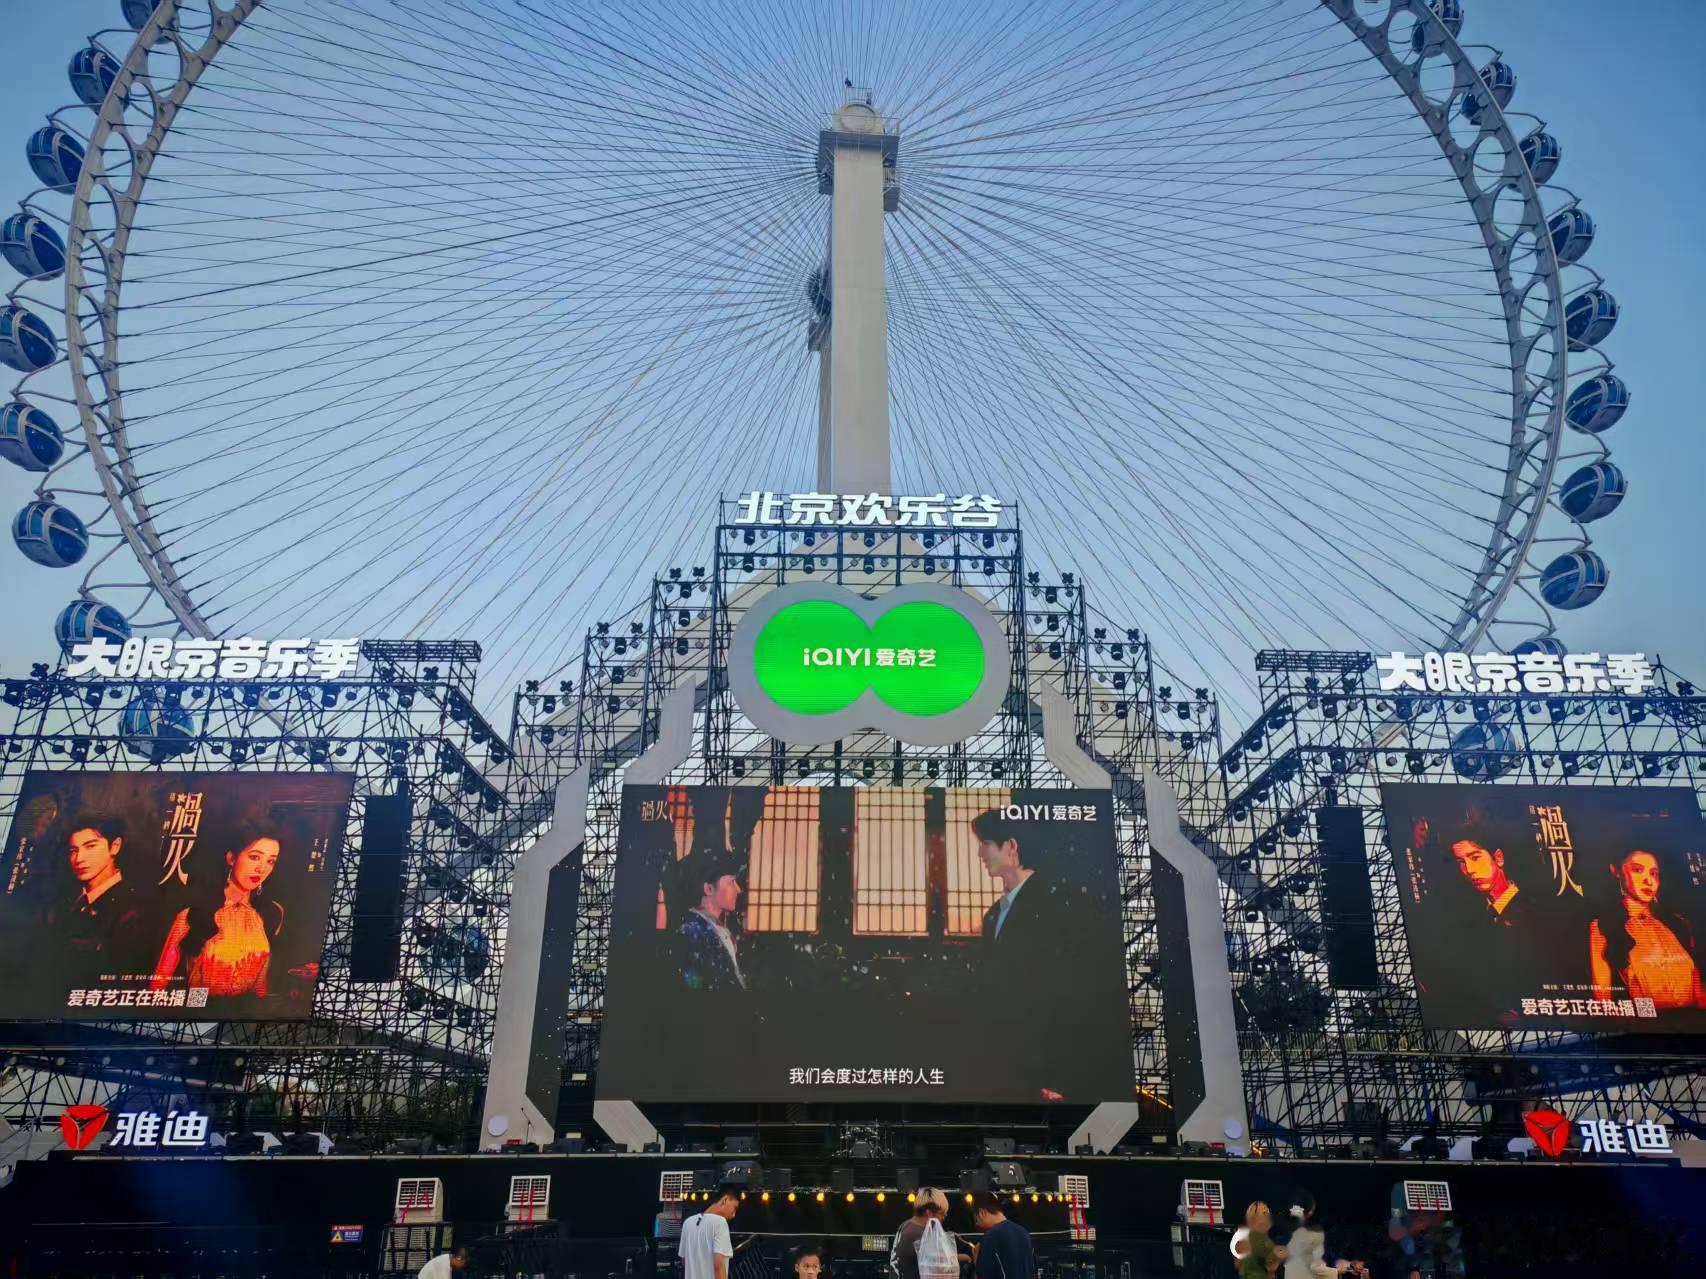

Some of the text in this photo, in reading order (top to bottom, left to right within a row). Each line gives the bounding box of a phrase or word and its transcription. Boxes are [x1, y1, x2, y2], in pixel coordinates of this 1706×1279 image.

[734, 491, 1002, 527] 北京欢乐谷
[66, 637, 360, 680] 大眼京音乐季
[875, 648, 936, 667] 爱奇艺
[1375, 651, 1655, 694] 大眼京音乐季
[1052, 804, 1097, 821] 爱奇艺
[67, 989, 186, 1007] 爱奇艺正在热播
[1521, 998, 1635, 1017] 爱奇艺正在热播
[788, 1067, 945, 1085] 我们会度过怎样的人生
[109, 1110, 208, 1146] 雅迪
[1577, 1118, 1673, 1154] 雅迪
